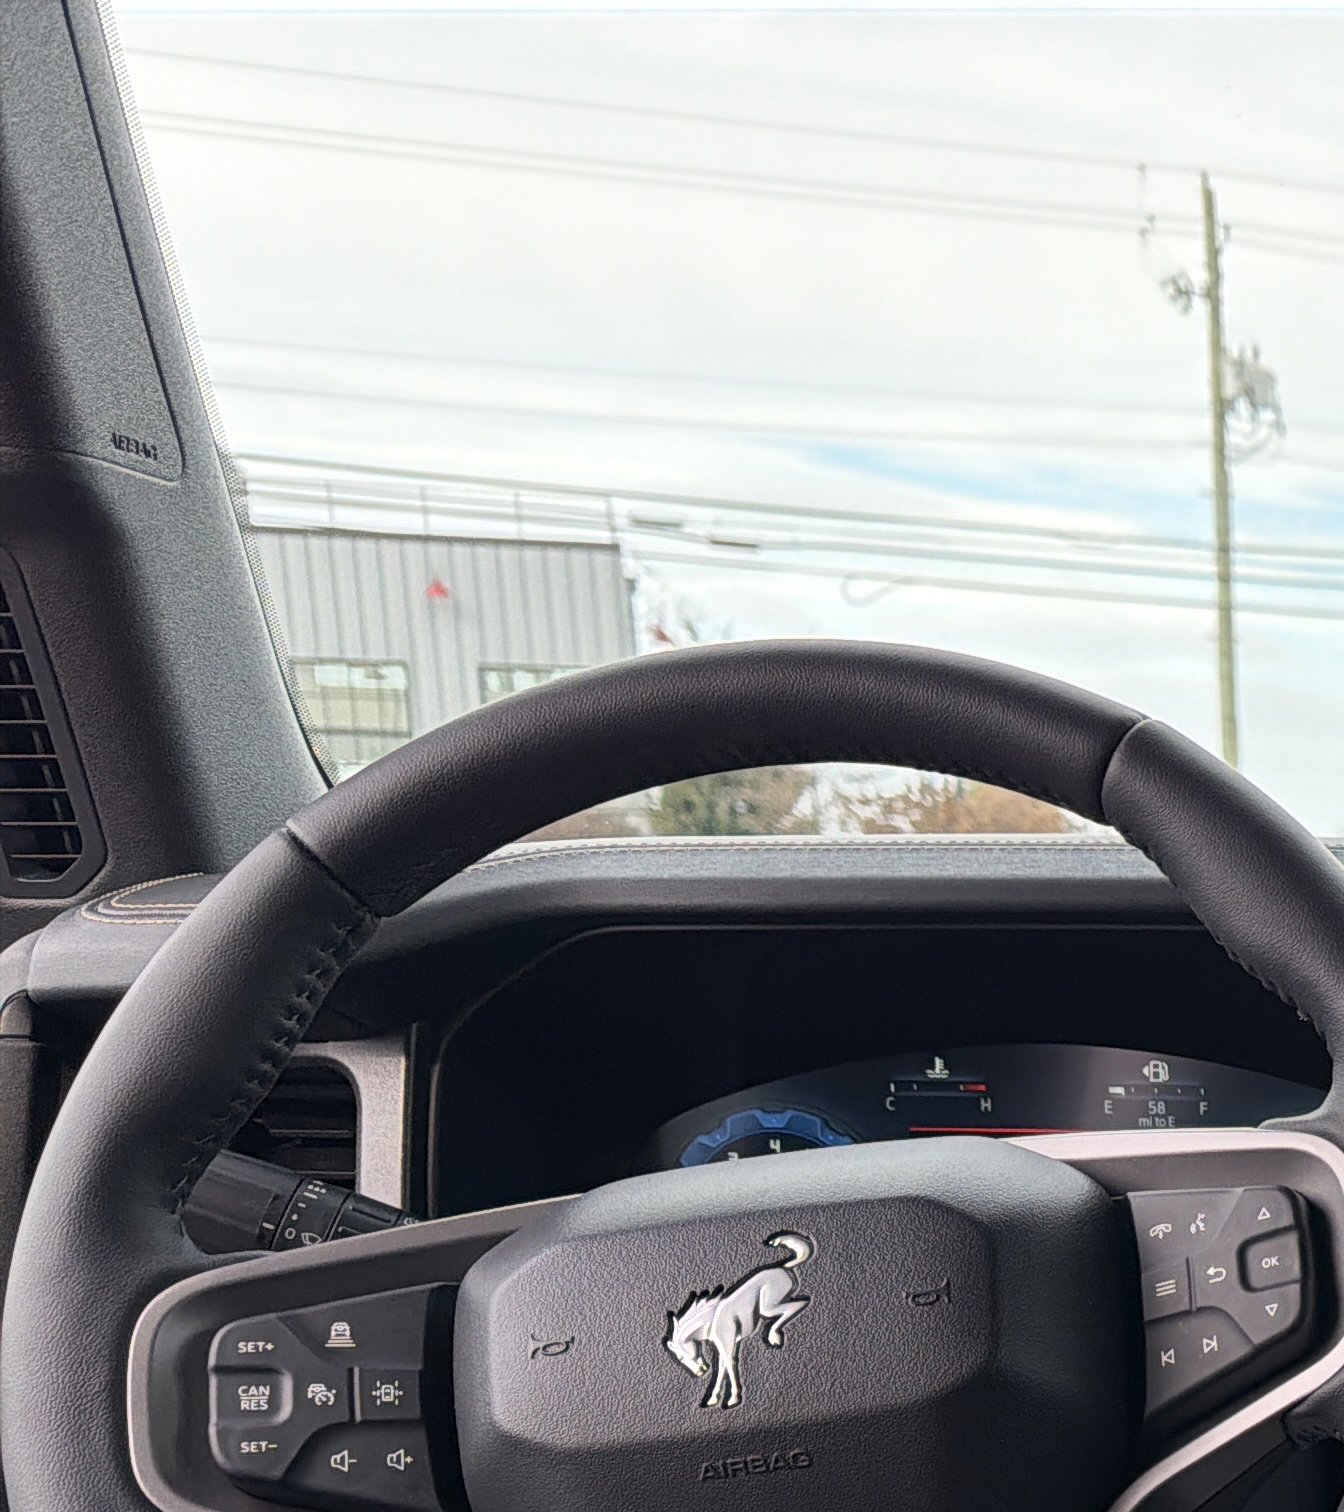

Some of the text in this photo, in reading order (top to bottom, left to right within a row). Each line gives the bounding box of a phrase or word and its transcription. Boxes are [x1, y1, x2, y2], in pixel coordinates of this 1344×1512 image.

[885, 1097, 896, 1112] C
[980, 1097, 992, 1113] H
[1104, 1100, 1113, 1115] E
[1148, 1101, 1167, 1115] 58
[1199, 1101, 1209, 1116] F
[1166, 1116, 1176, 1128] E
[1261, 1255, 1280, 1269] OK
[238, 1385, 271, 1397] CAN
[240, 1399, 269, 1411] RES
[699, 1449, 814, 1483] AIRBAG
